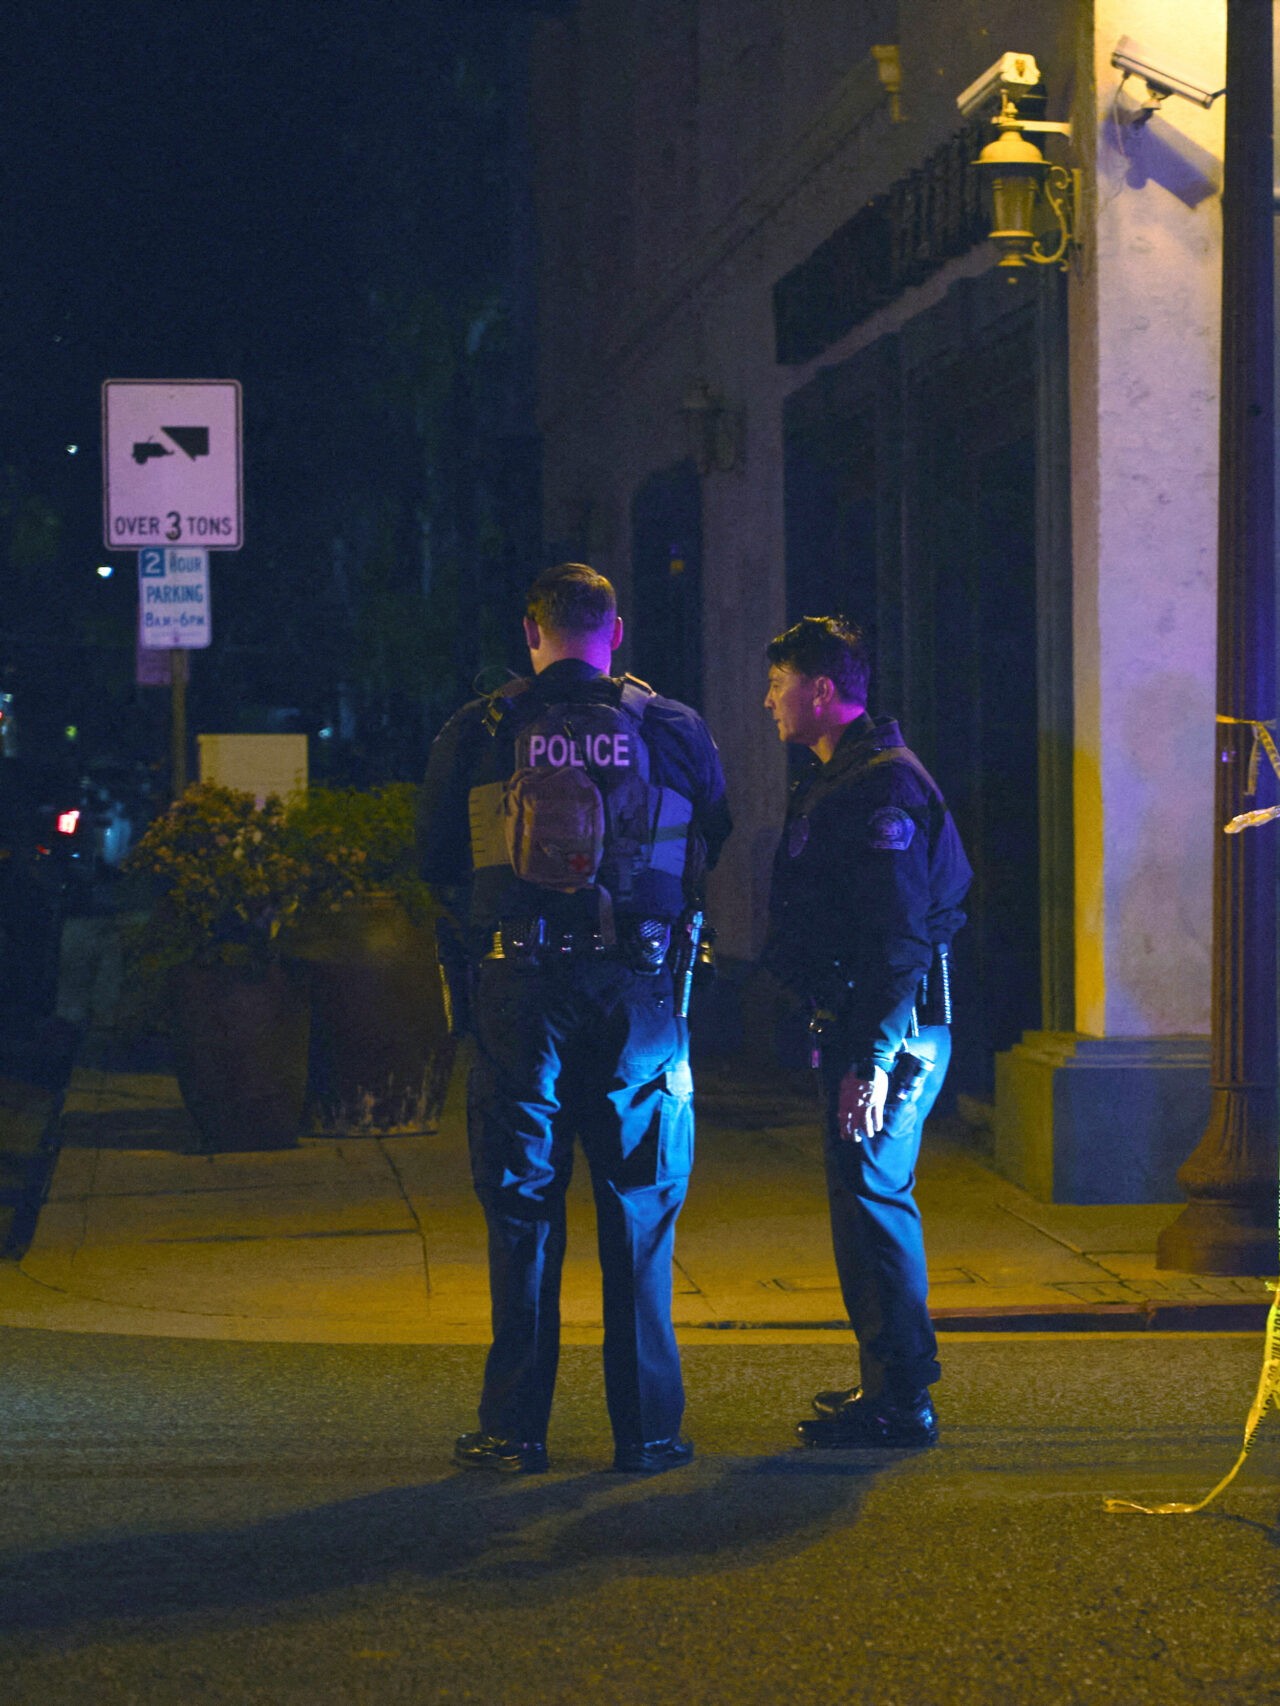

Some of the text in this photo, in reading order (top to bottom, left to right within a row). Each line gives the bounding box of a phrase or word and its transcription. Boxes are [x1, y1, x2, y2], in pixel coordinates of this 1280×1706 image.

[114, 510, 233, 541] OVER 3 TONS
[145, 552, 161, 574] 2
[146, 585, 204, 604] PARKING
[529, 733, 631, 768] POLICE
